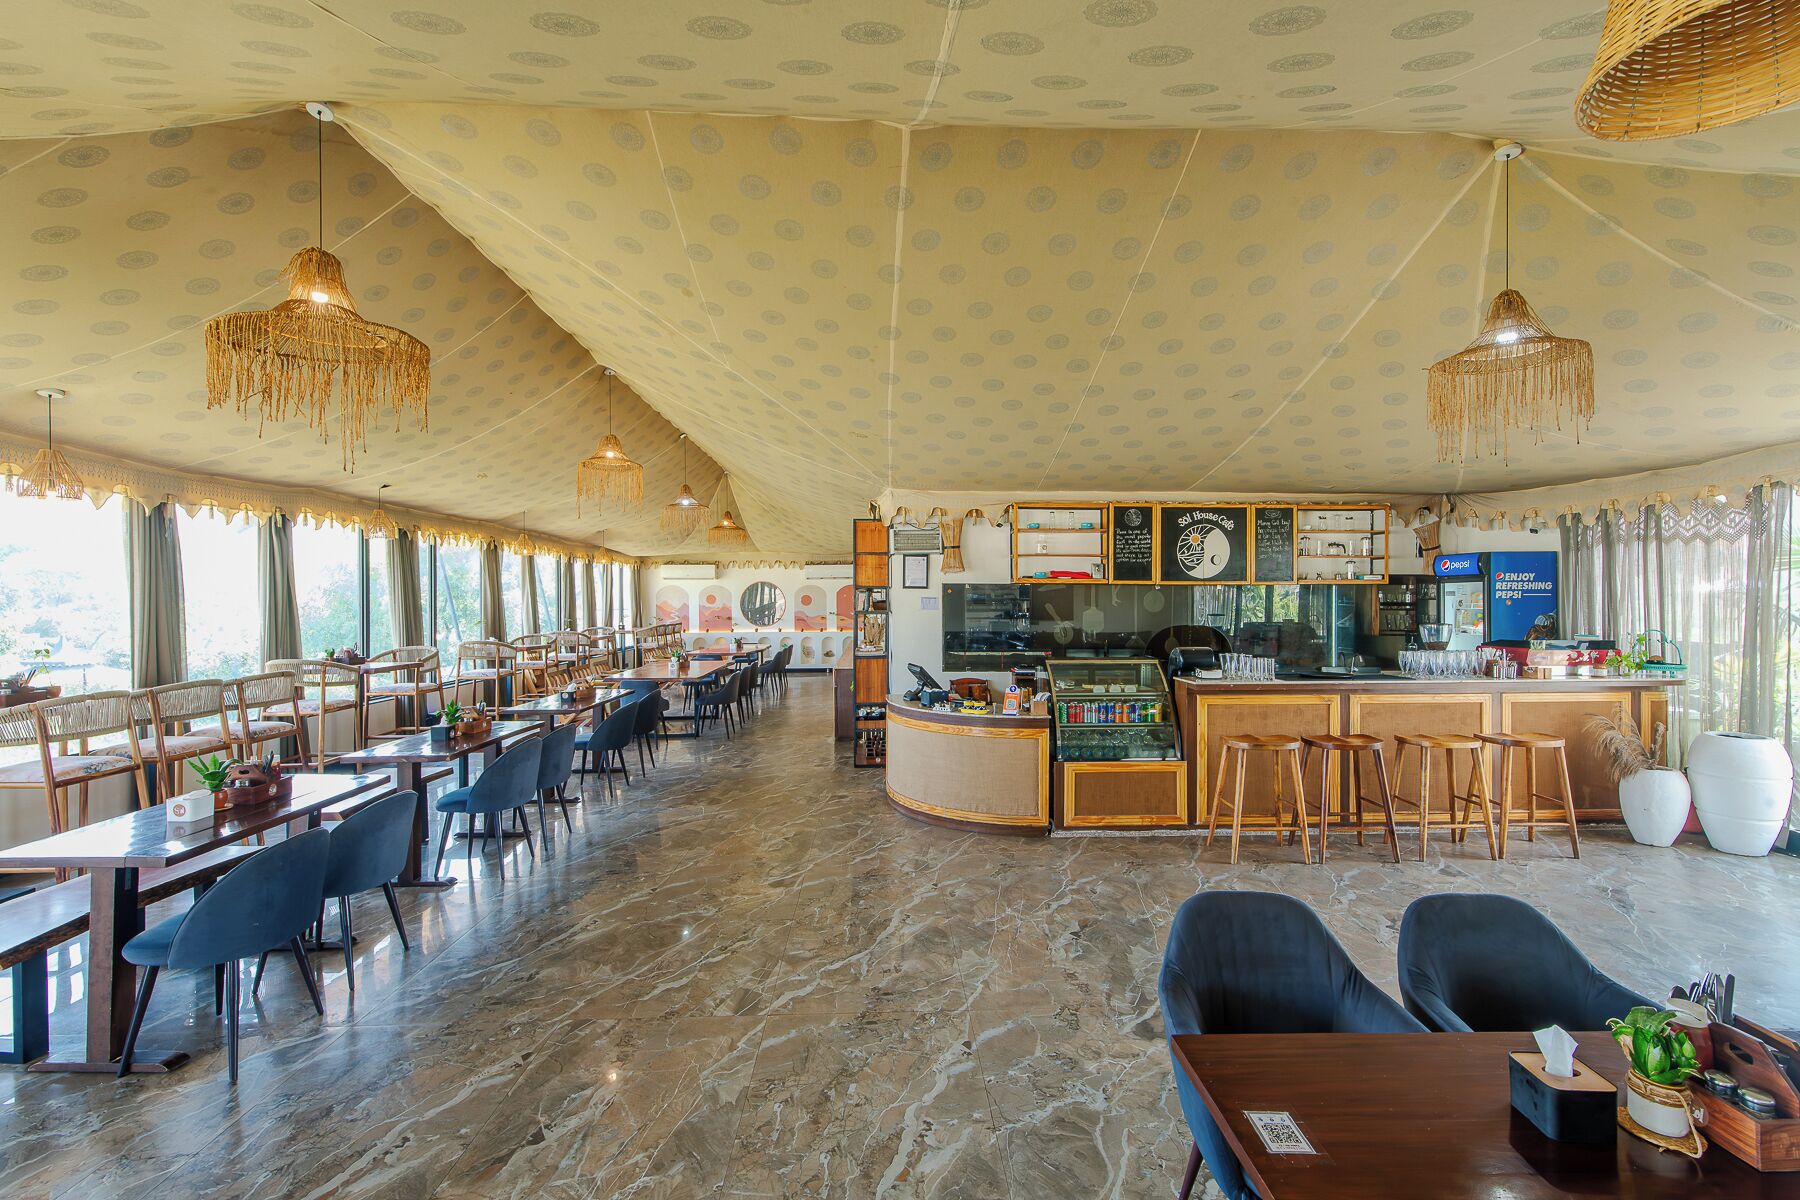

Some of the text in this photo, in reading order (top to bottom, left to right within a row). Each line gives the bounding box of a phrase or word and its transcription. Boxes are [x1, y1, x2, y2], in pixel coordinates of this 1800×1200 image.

[1193, 511, 1218, 521] House
[1451, 560, 1470, 570] pepsi
[1505, 573, 1535, 581] ENJOY
[1496, 582, 1552, 590] REFRESHING
